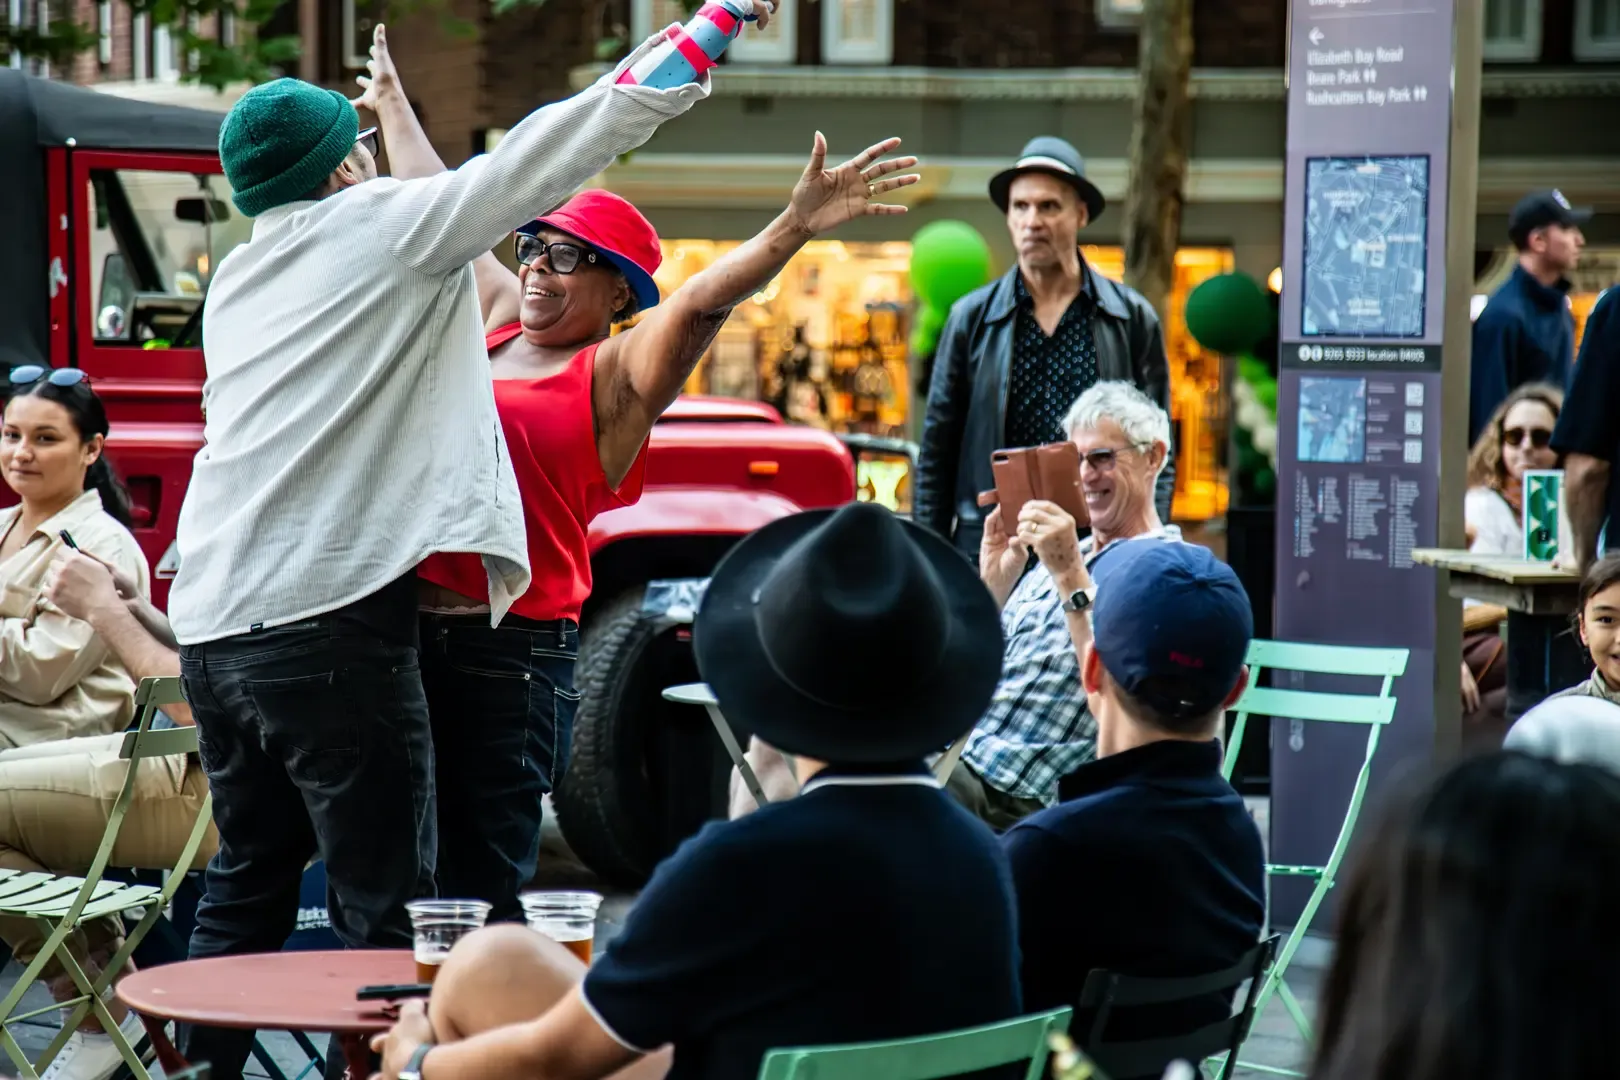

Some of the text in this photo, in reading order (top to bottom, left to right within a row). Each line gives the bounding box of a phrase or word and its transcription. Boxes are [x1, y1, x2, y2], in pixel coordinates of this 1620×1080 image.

[1308, 46, 1404, 66] Elizabeth Bay Road
[1338, 68, 1361, 84] Park
[1307, 87, 1411, 106] Rushcutters Bay Park
[1367, 347, 1398, 361] location
